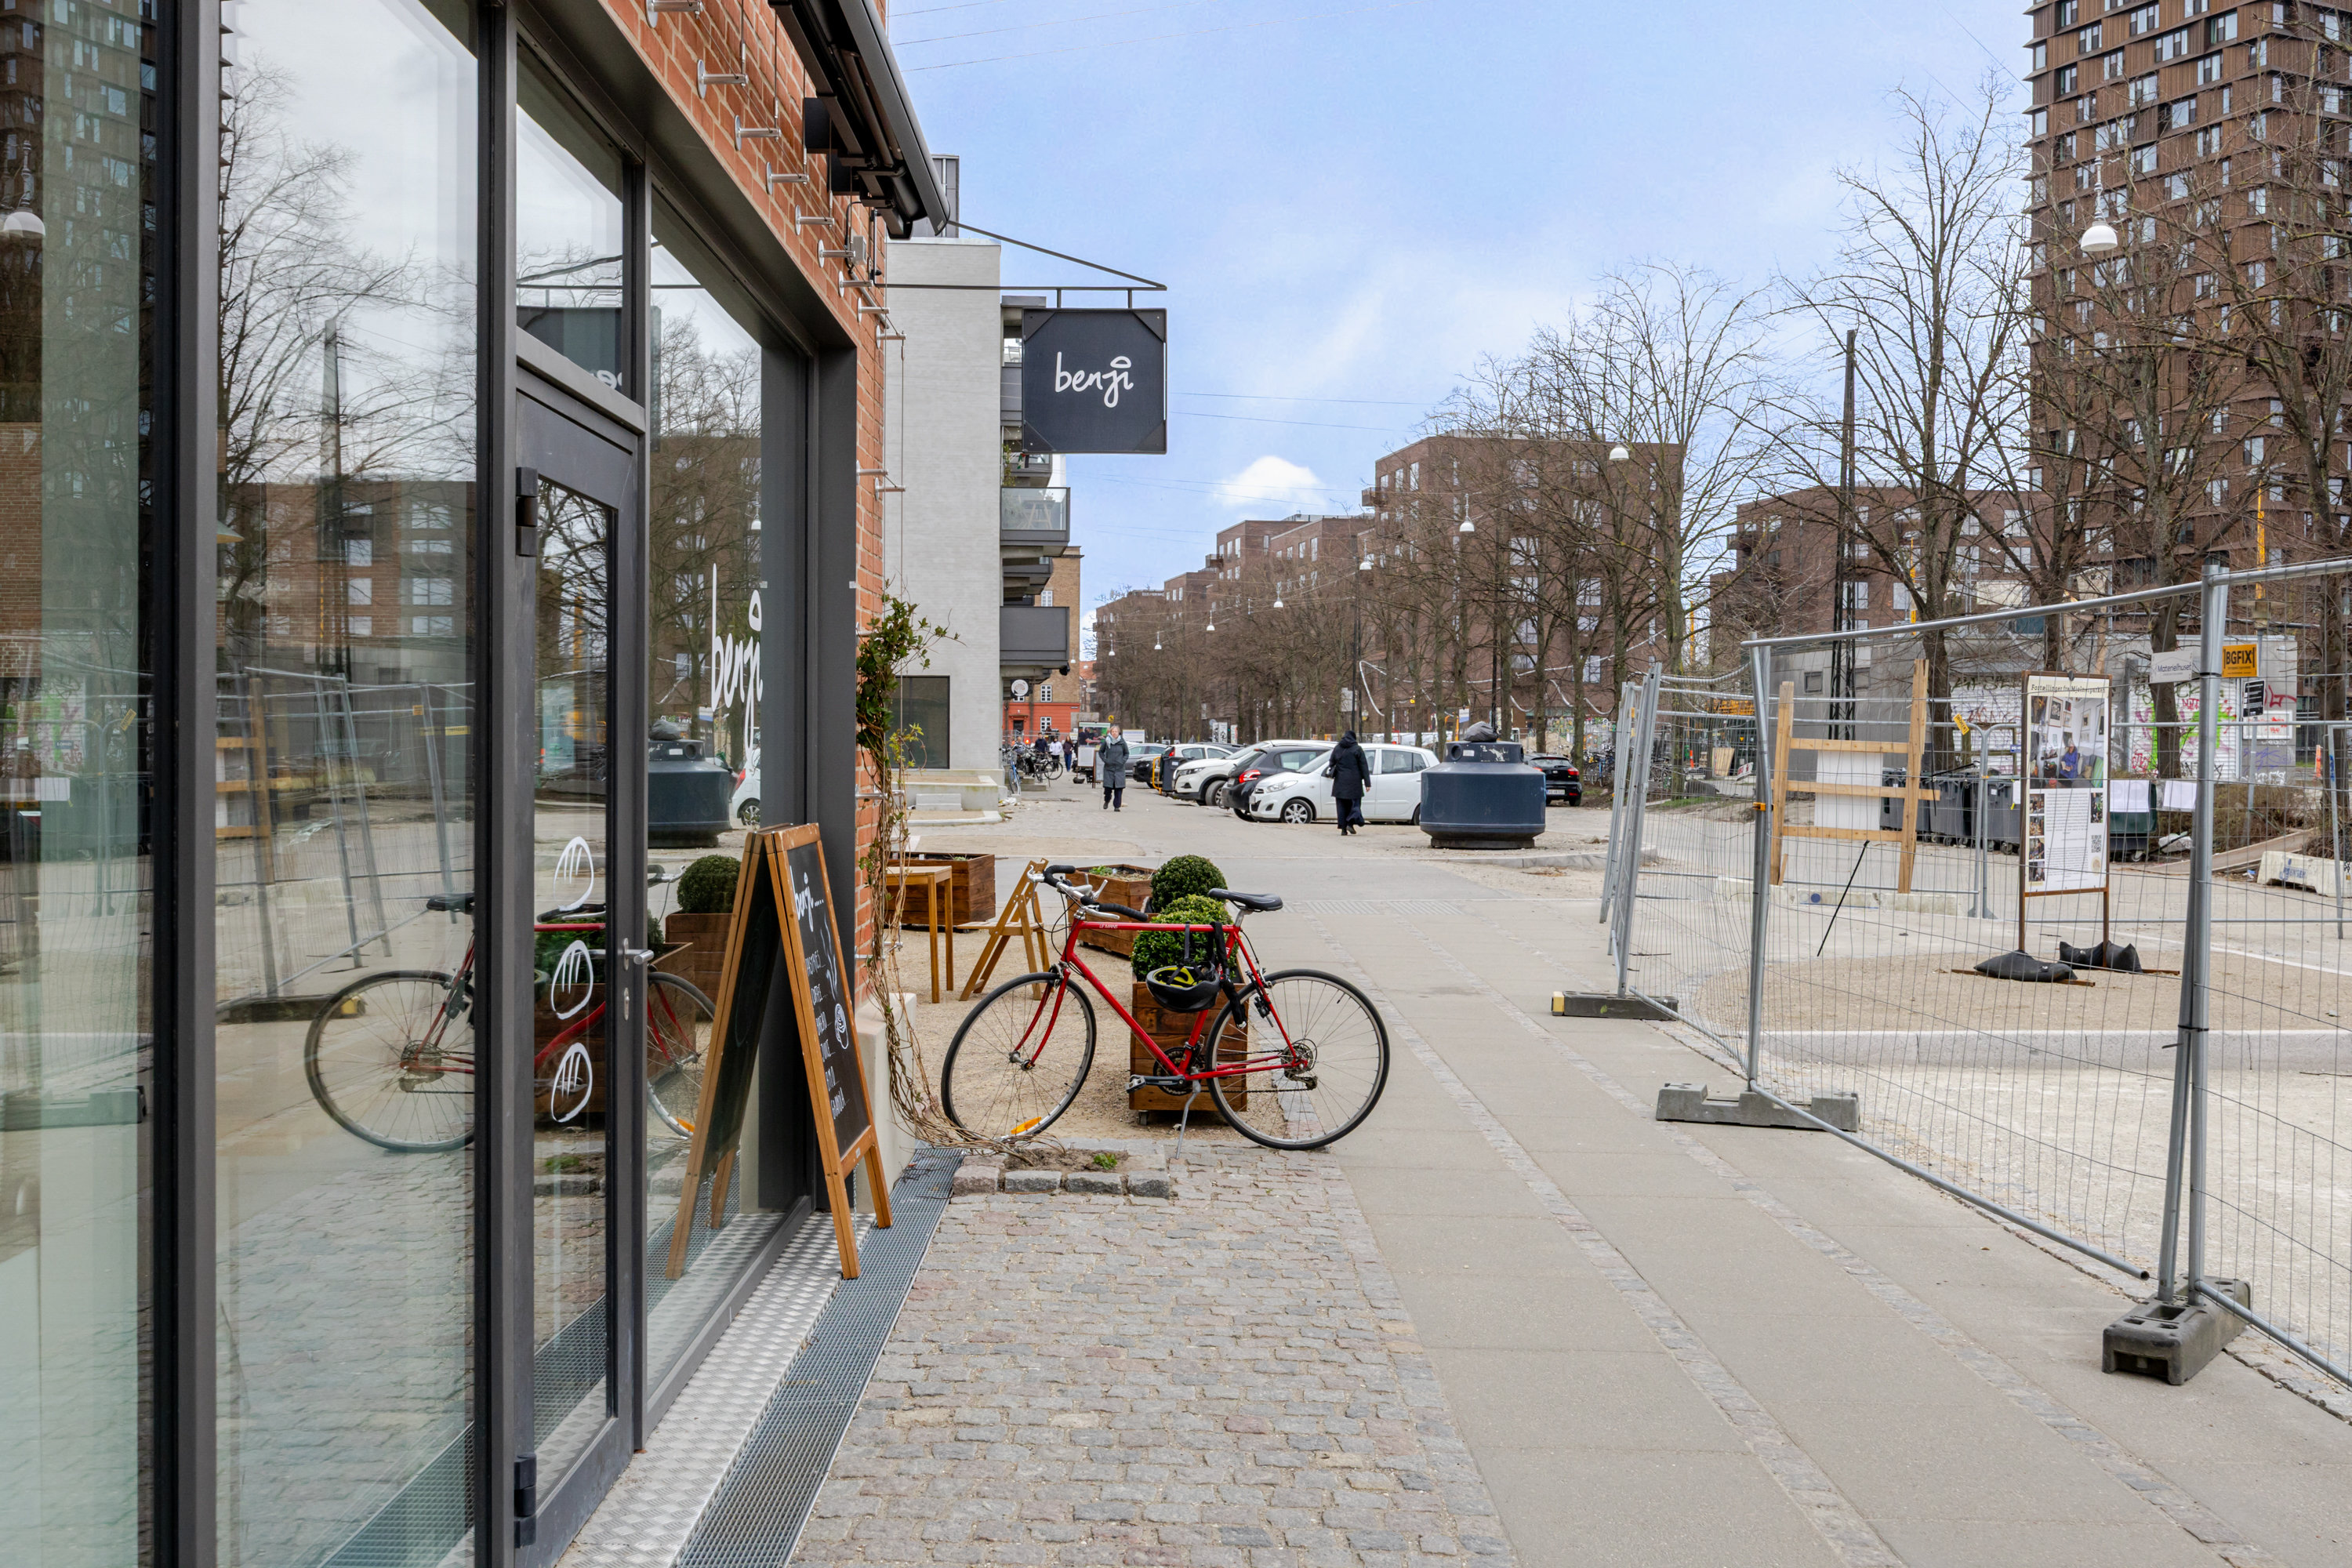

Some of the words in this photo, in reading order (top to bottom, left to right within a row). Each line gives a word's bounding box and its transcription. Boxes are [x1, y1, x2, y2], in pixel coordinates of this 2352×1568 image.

[1055, 351, 1134, 408] benji
[711, 563, 763, 764] benji
[2226, 650, 2252, 665] BGFIX
